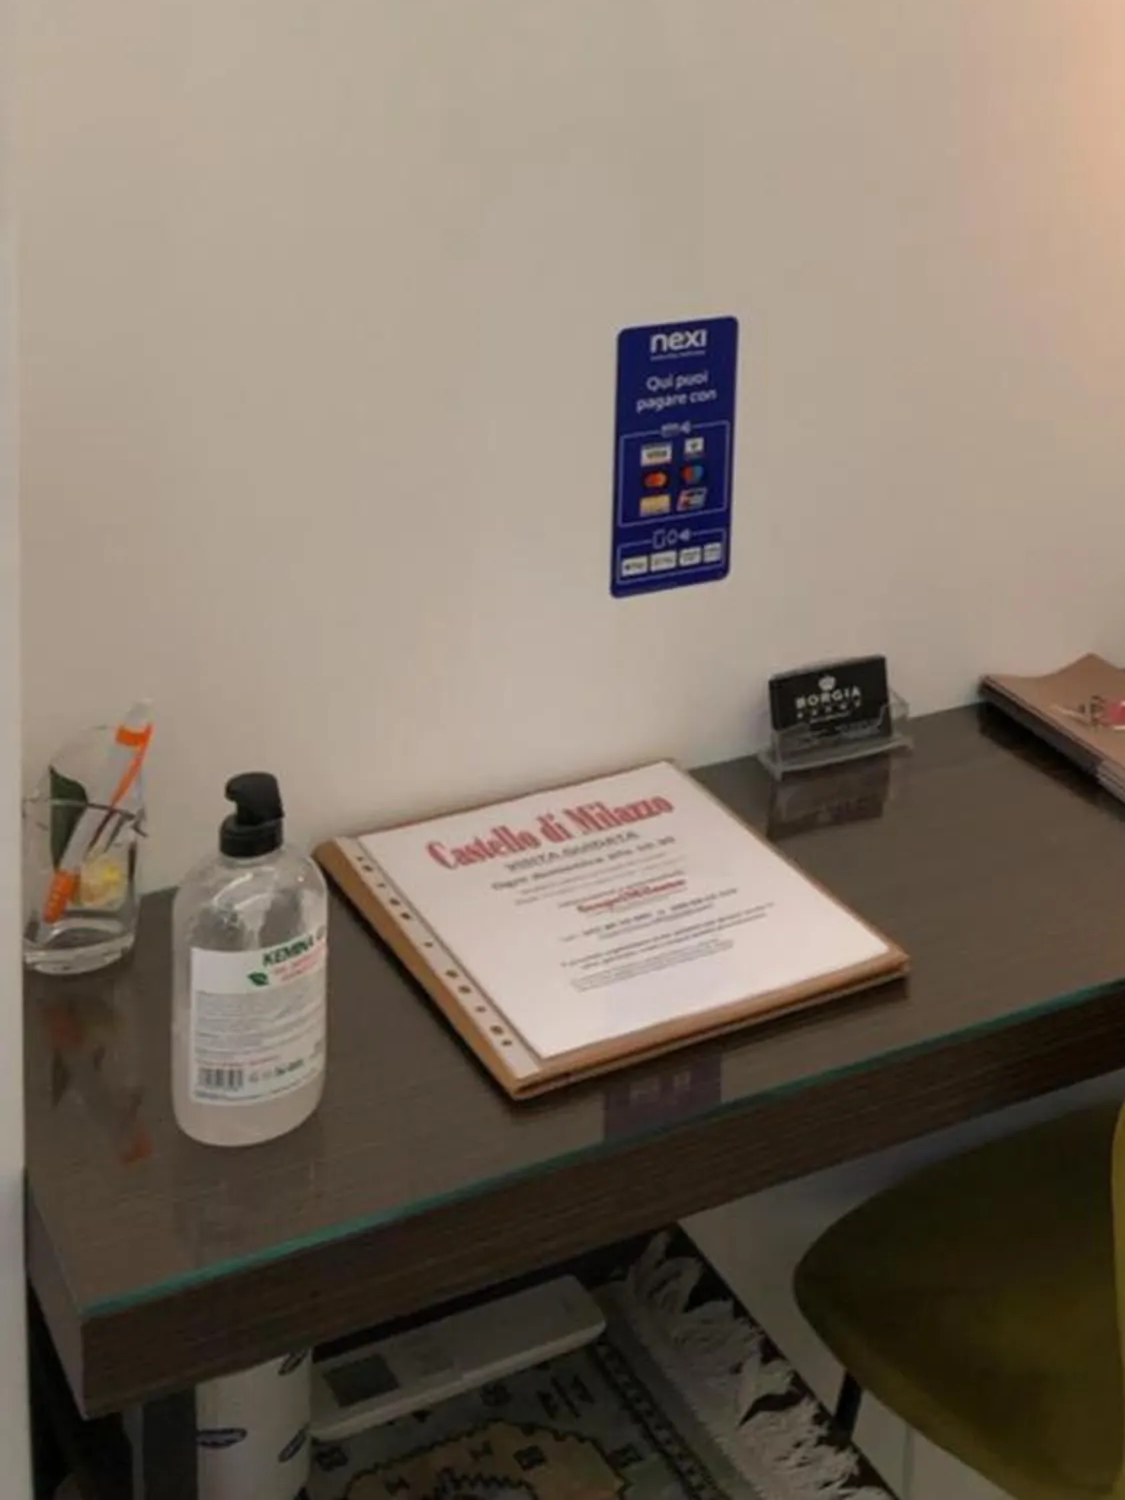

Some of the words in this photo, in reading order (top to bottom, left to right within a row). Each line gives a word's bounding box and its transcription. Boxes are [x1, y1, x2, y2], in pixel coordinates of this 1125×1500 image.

[650, 329, 708, 353] nexi
[646, 373, 674, 392] Qui
[675, 369, 709, 390] puoi
[636, 393, 688, 414] pagare
[689, 388, 718, 404] con
[795, 685, 862, 710] BORGIA
[426, 824, 542, 870] Castello
[536, 813, 574, 843] di
[562, 796, 675, 835] Milazzo
